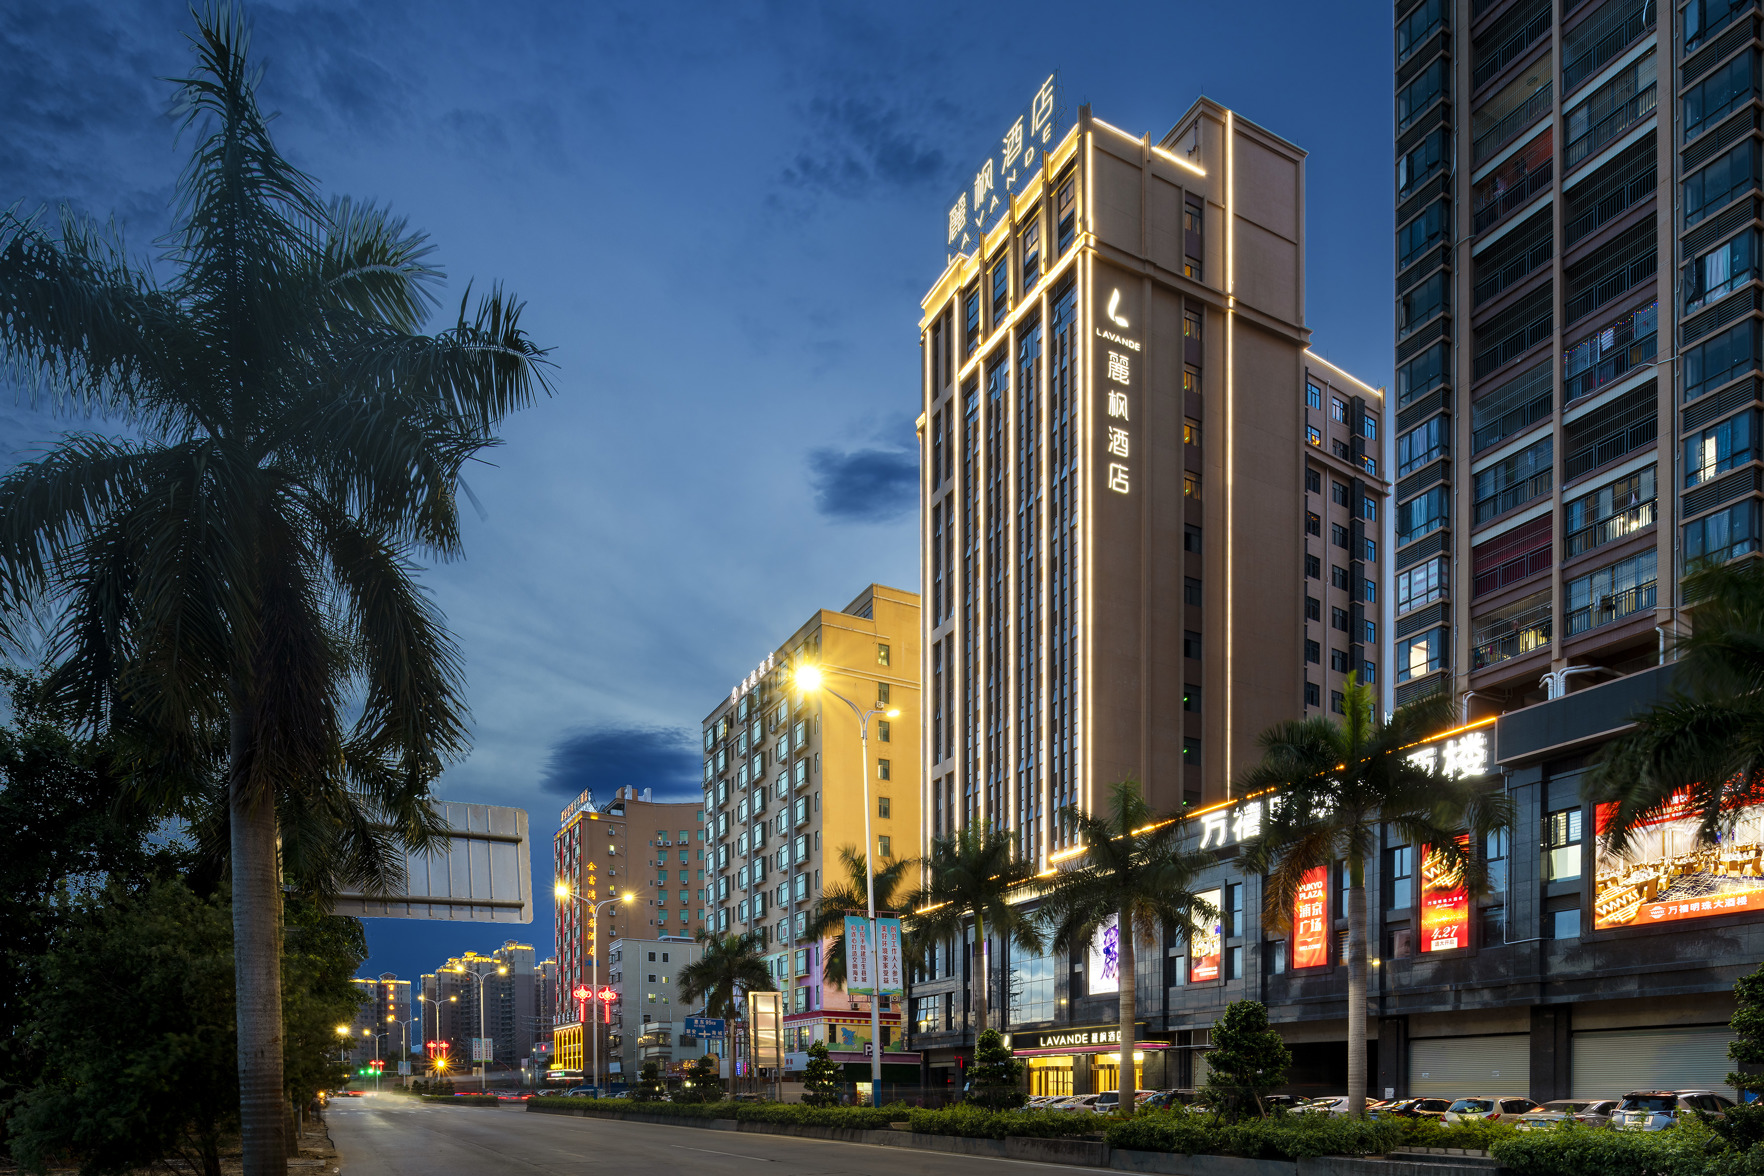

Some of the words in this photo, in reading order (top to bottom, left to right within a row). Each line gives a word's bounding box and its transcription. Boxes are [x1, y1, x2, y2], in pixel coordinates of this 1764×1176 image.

[1096, 328, 1141, 352] LAVANDE
[1299, 889, 1323, 900] PLAZA
[1299, 902, 1323, 918] 浦京
[1300, 918, 1322, 934] 广场
[1431, 925, 1458, 940] 4.27
[859, 925, 867, 983] 手拉手创建卫生县城
[881, 926, 889, 984] 美好环境家家受益
[890, 926, 898, 984] 创卫工作人人参与
[1040, 1033, 1089, 1047] LAVANDE
